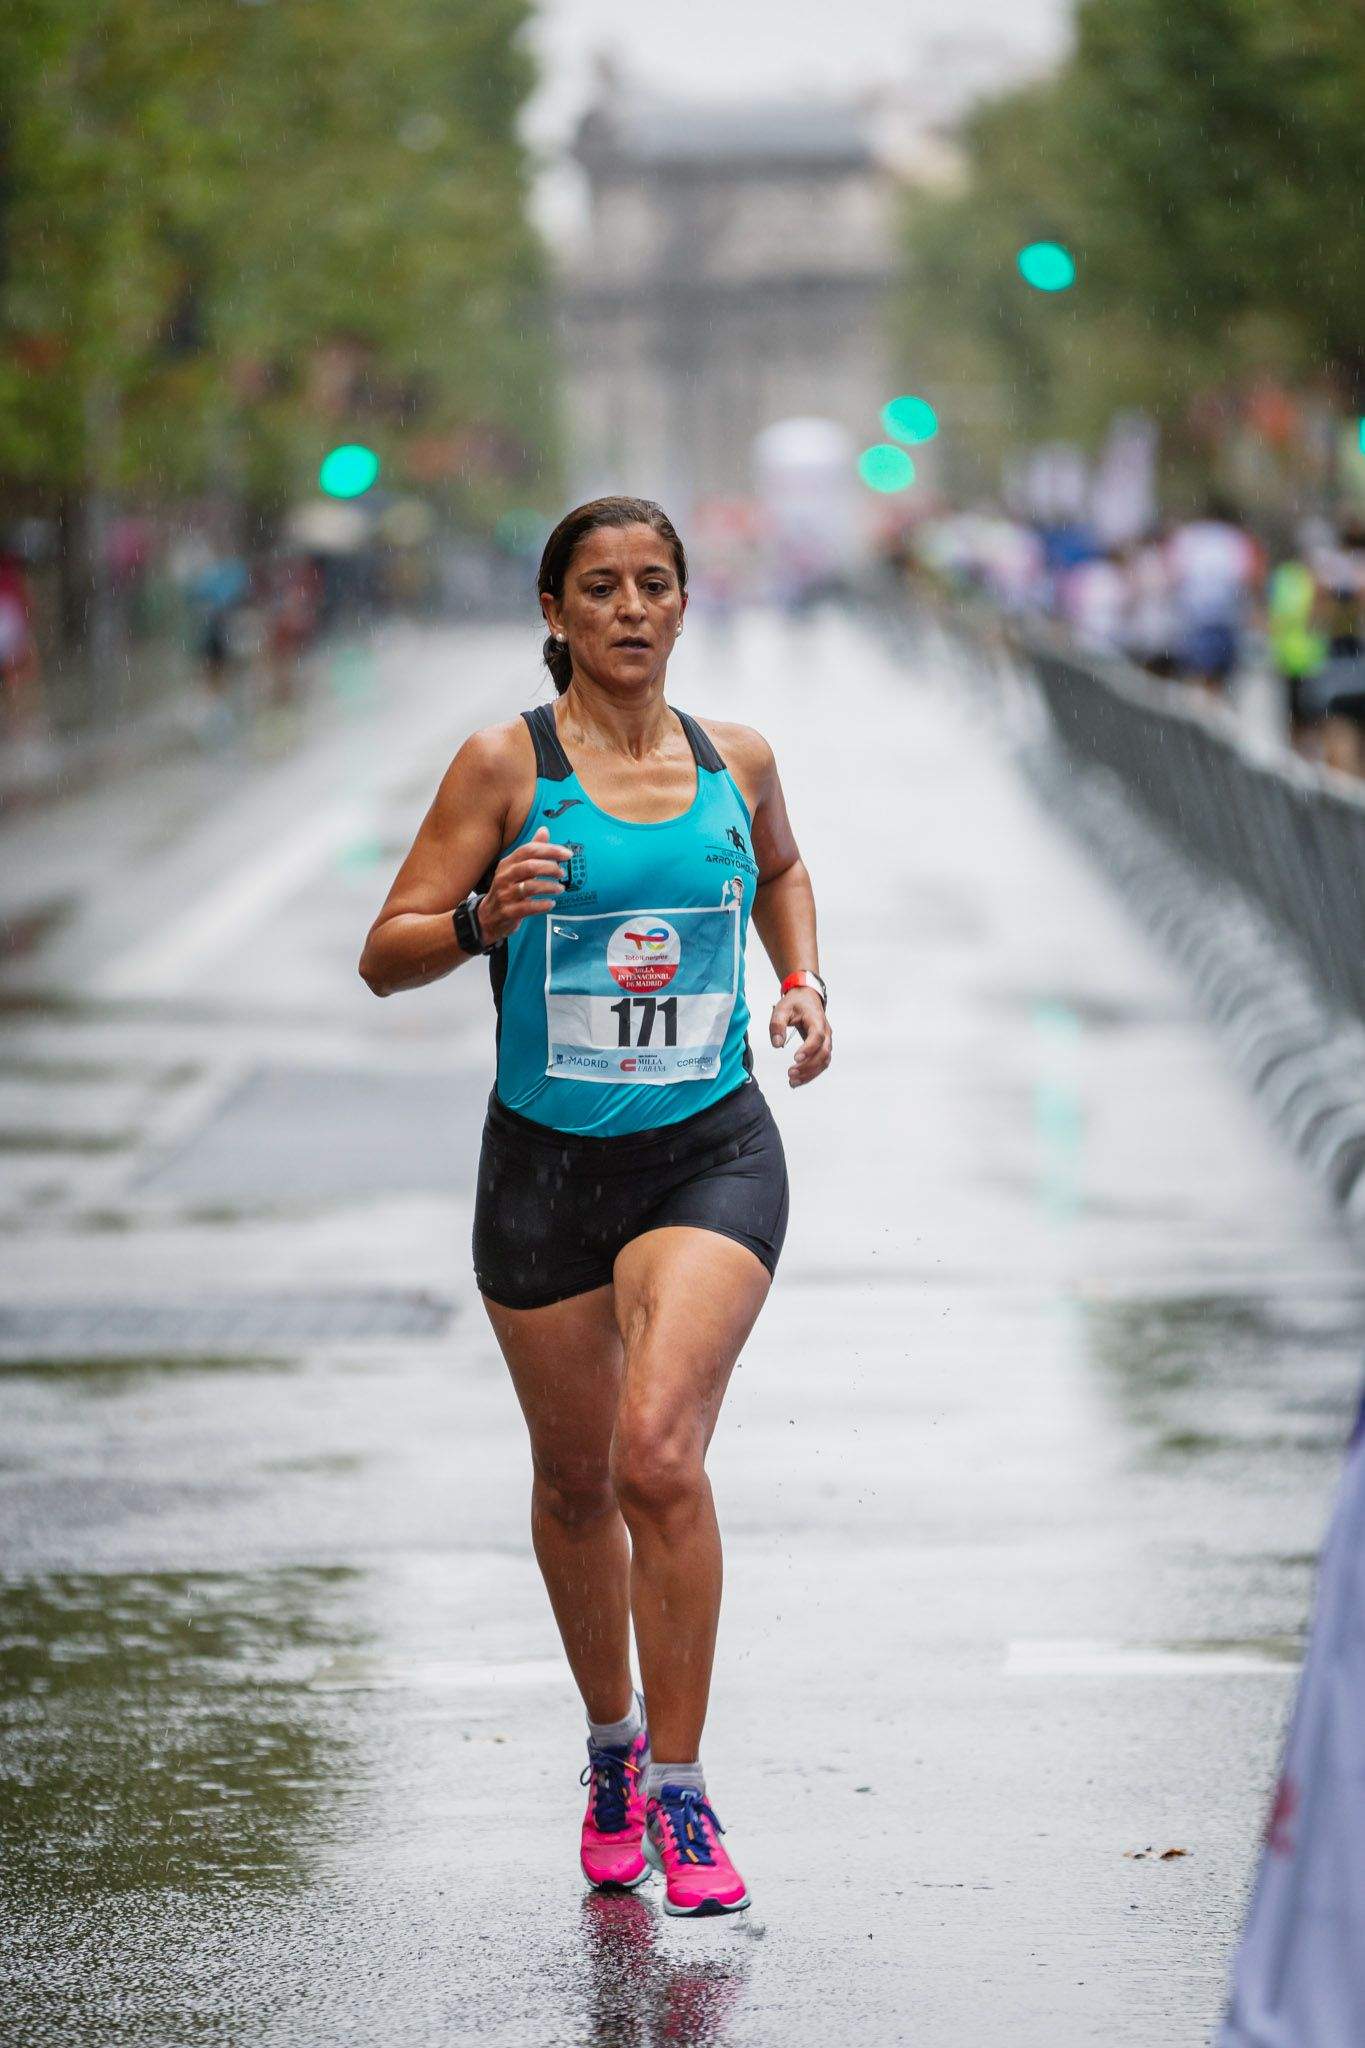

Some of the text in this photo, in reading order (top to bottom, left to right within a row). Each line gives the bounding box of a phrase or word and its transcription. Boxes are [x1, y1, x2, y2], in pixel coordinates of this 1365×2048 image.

[618, 973, 670, 981] INTERNACIONAL
[635, 980, 663, 988] MADRID
[611, 997, 678, 1047] 171
[568, 1056, 609, 1069] MADRID
